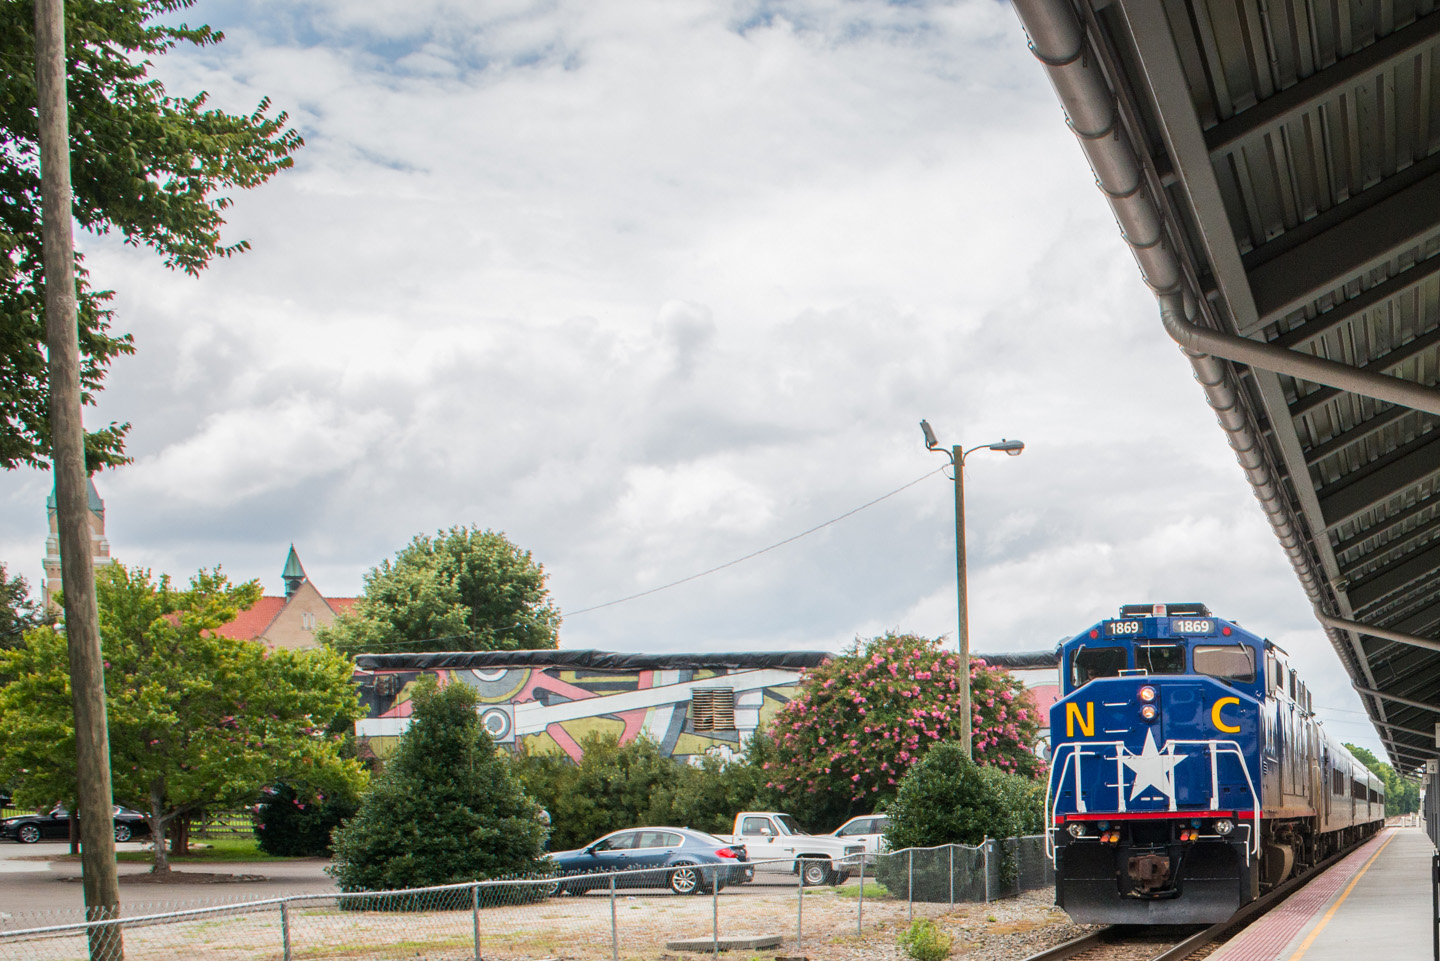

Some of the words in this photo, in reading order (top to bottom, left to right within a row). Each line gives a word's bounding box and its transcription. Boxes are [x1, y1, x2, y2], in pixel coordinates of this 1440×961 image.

[1110, 621, 1139, 635] 1869
[1177, 619, 1210, 633] 1869
[1066, 702, 1095, 737] N
[1211, 696, 1241, 734] C
[1430, 764, 1435, 772] 4
